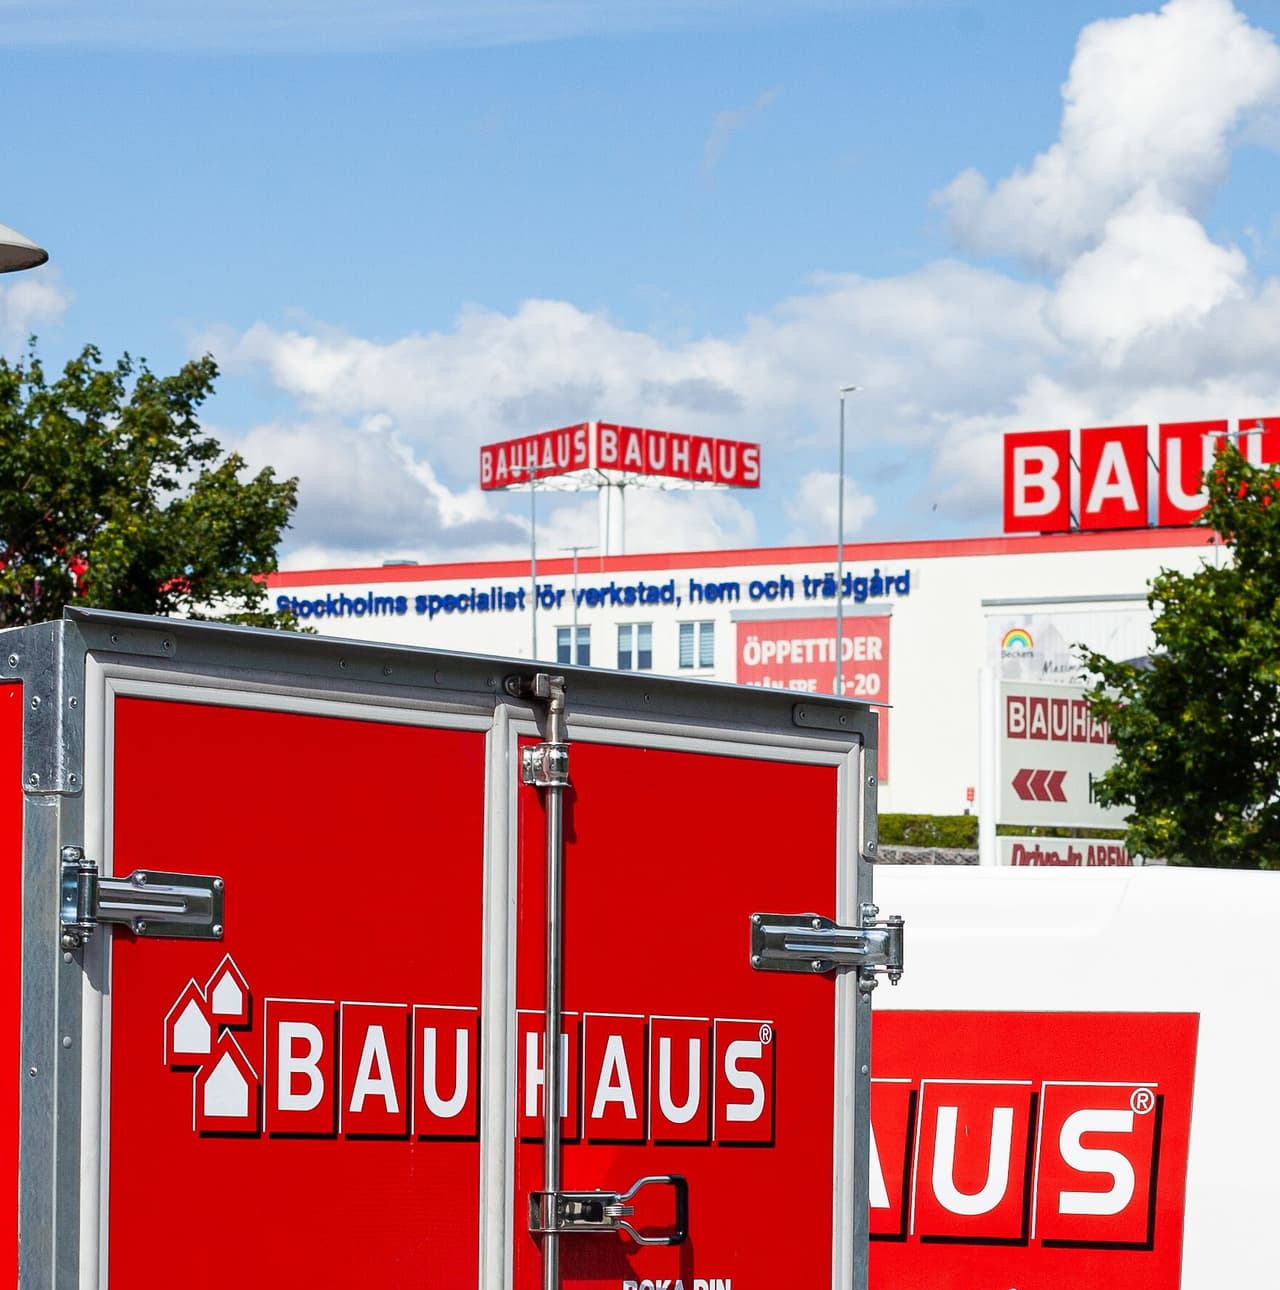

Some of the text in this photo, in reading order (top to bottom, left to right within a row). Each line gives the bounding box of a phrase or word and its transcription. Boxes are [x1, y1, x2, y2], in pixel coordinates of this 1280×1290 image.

[482, 430, 586, 483] BAUHAUS
[600, 430, 759, 481] BAUHAUS
[276, 591, 407, 618] Stockholms
[415, 586, 526, 621] specialist
[690, 578, 740, 604] hem
[749, 574, 794, 600] och
[803, 569, 911, 603] trädgård
